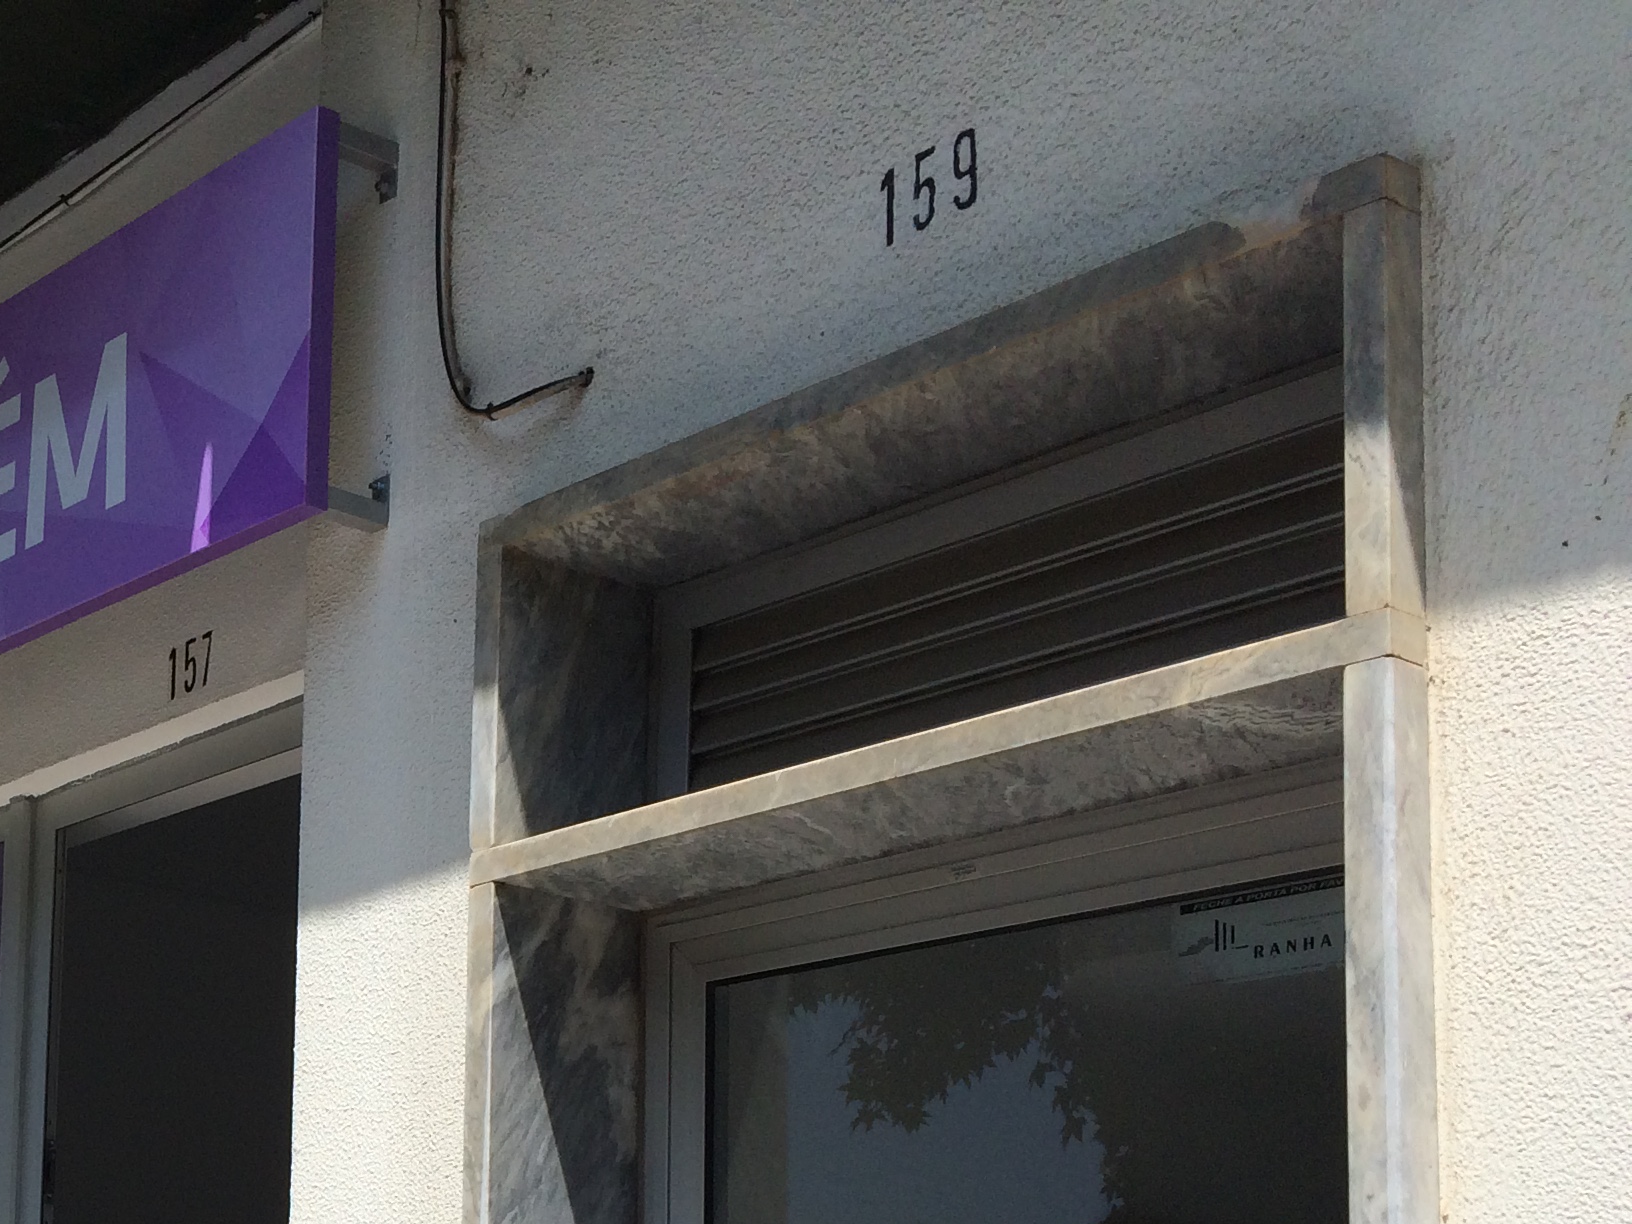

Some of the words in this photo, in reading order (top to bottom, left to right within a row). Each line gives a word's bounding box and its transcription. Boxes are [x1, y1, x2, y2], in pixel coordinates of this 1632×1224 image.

[880, 128, 977, 247] 159
[168, 629, 213, 701] 157
[1235, 896, 1245, 904] A
[1246, 889, 1288, 902] PORTA
[1290, 882, 1316, 894] POR
[1253, 933, 1333, 959] RANHA
